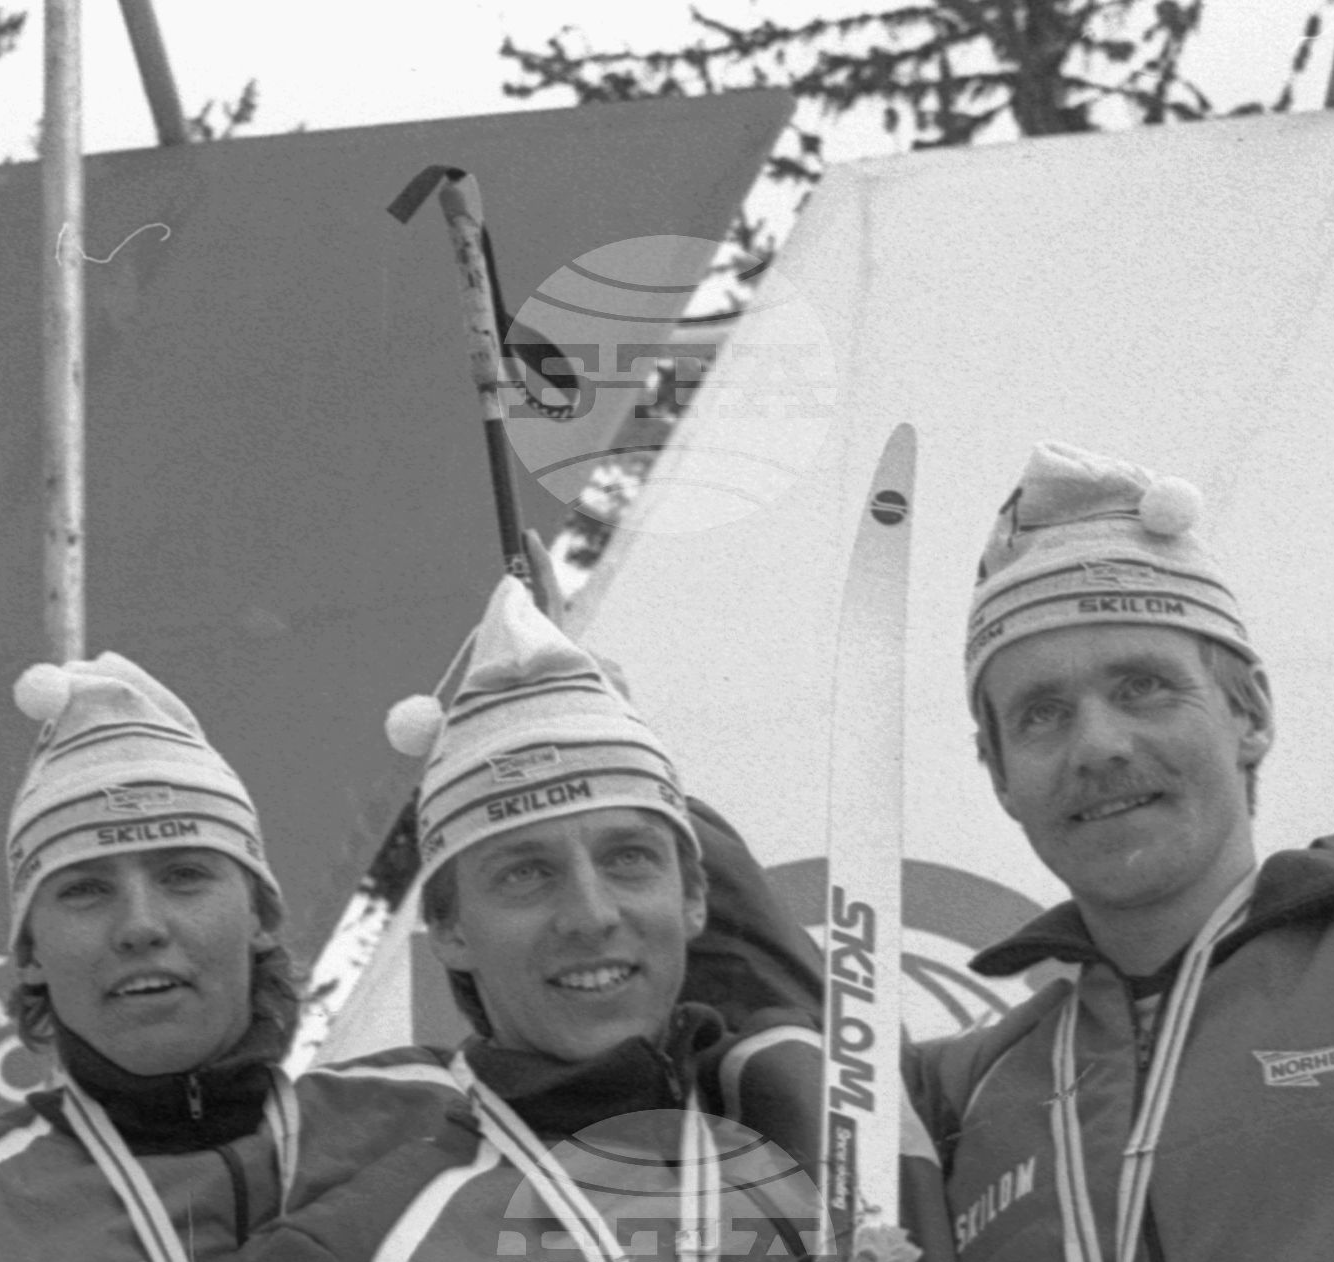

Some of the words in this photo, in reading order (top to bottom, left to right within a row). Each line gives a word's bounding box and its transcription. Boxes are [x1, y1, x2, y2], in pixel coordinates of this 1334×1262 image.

[1077, 596, 1186, 616] SKILOM
[486, 779, 593, 822] SKILOM
[97, 819, 200, 846] SKILOM
